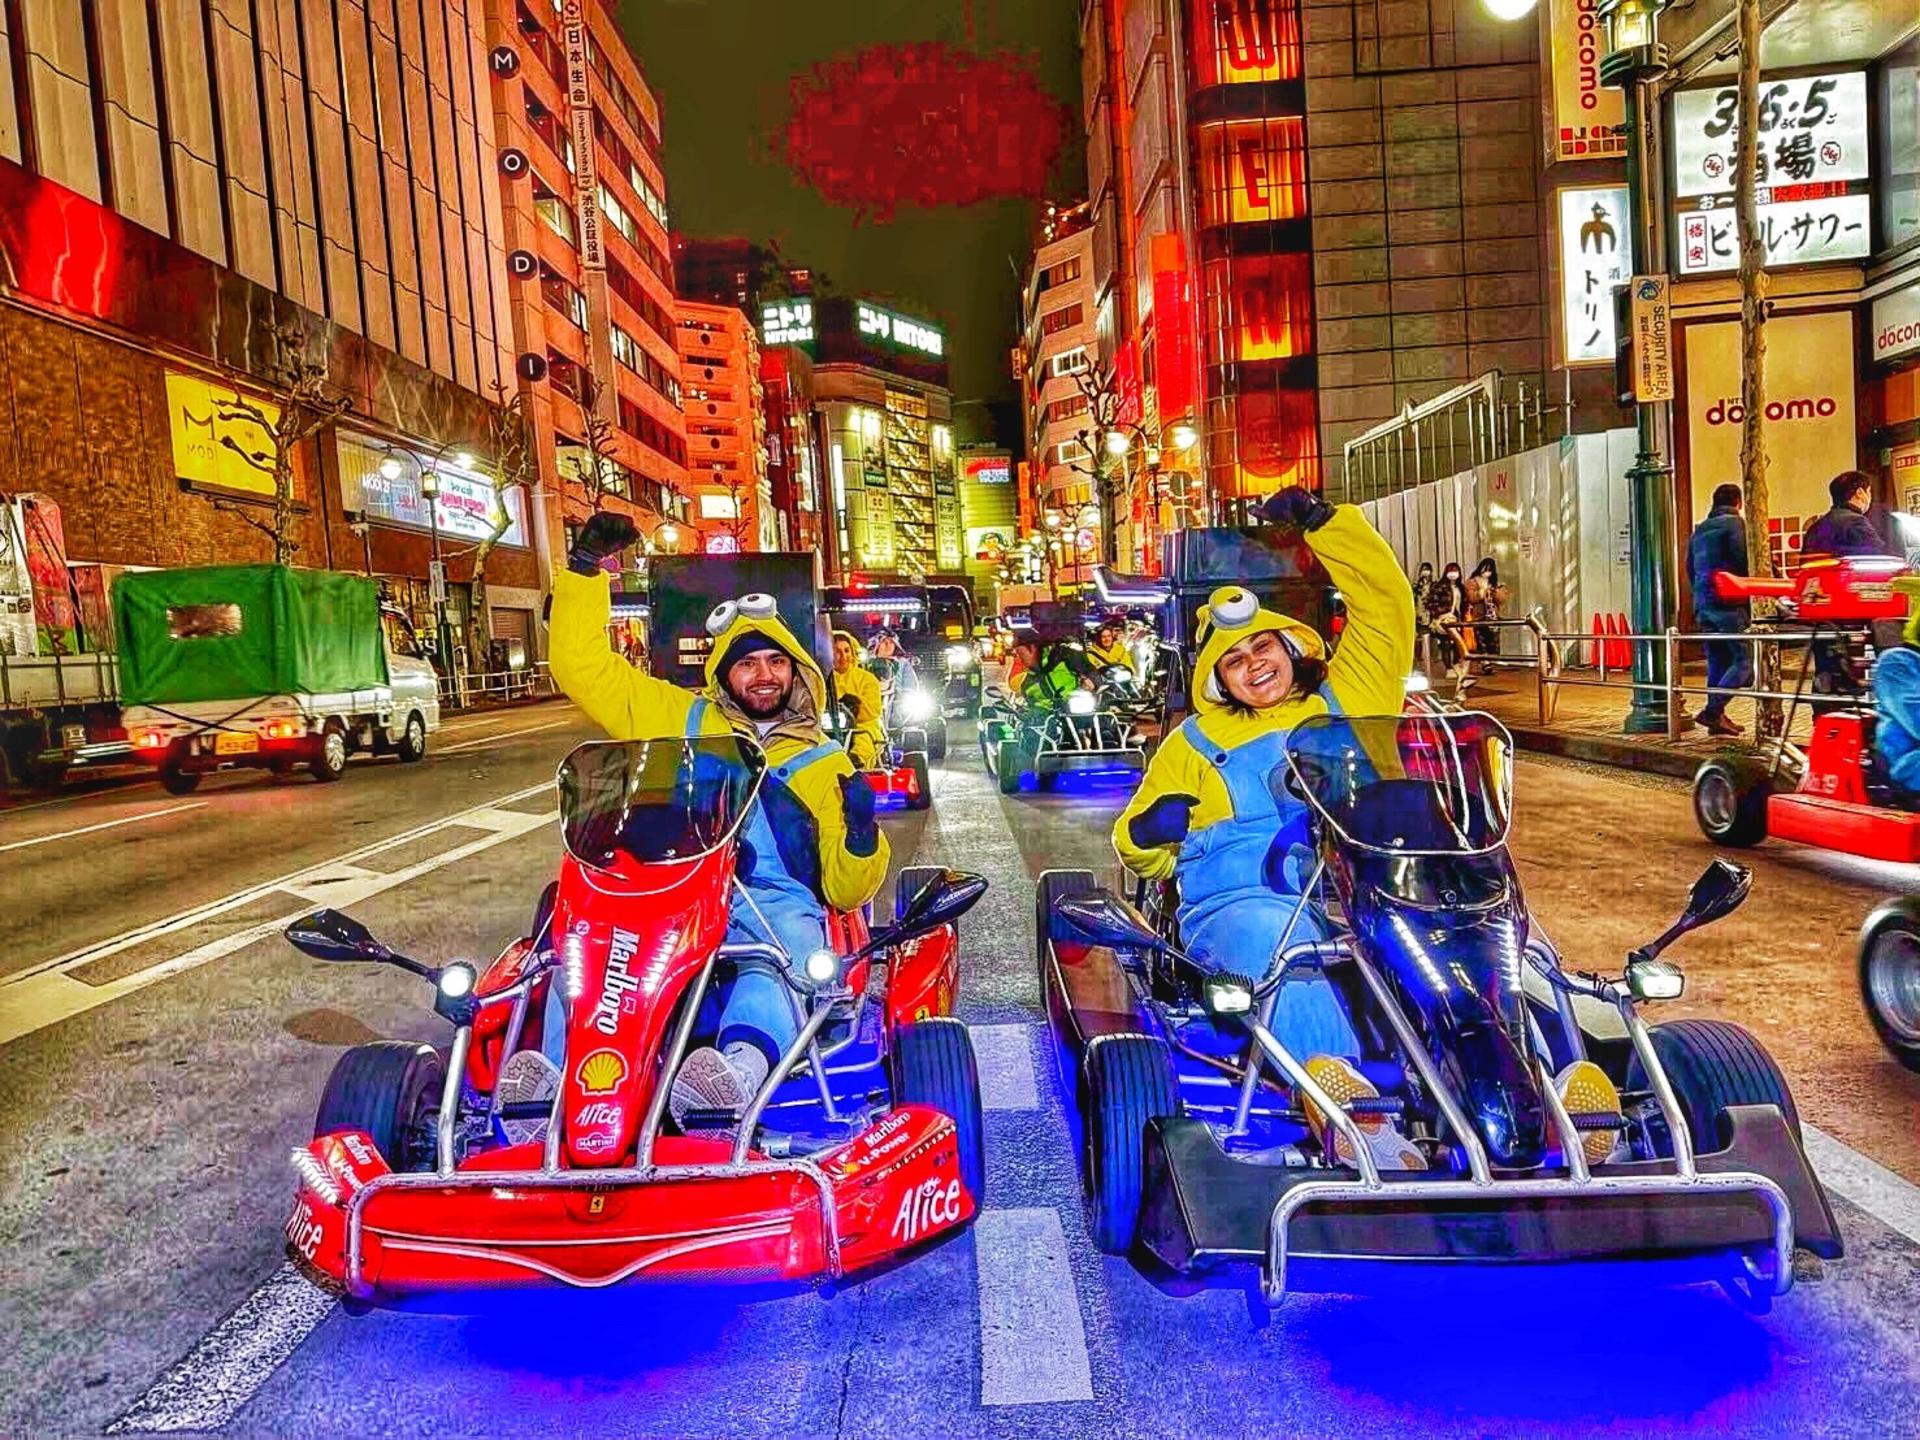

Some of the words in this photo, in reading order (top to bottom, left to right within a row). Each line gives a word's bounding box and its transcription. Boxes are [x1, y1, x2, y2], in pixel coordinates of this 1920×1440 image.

[568, 30, 586, 102] 日本生命
[1576, 0, 1598, 110] docomo
[1710, 211, 1863, 257] ビル・サワー
[763, 304, 811, 330] ニトリ
[1585, 269, 1602, 347] トリノ
[893, 319, 943, 356] NITORI
[1653, 305, 1668, 362] SECURITY
[1656, 363, 1670, 396] AREA
[1705, 398, 1837, 426] doomo
[595, 926, 641, 1036] Marlboro
[574, 1103, 622, 1126] Alice
[864, 1112, 911, 1147] Marlboro
[578, 1138, 615, 1150] MARTINI
[286, 1199, 324, 1260] Alice
[891, 1177, 961, 1242] Alice
